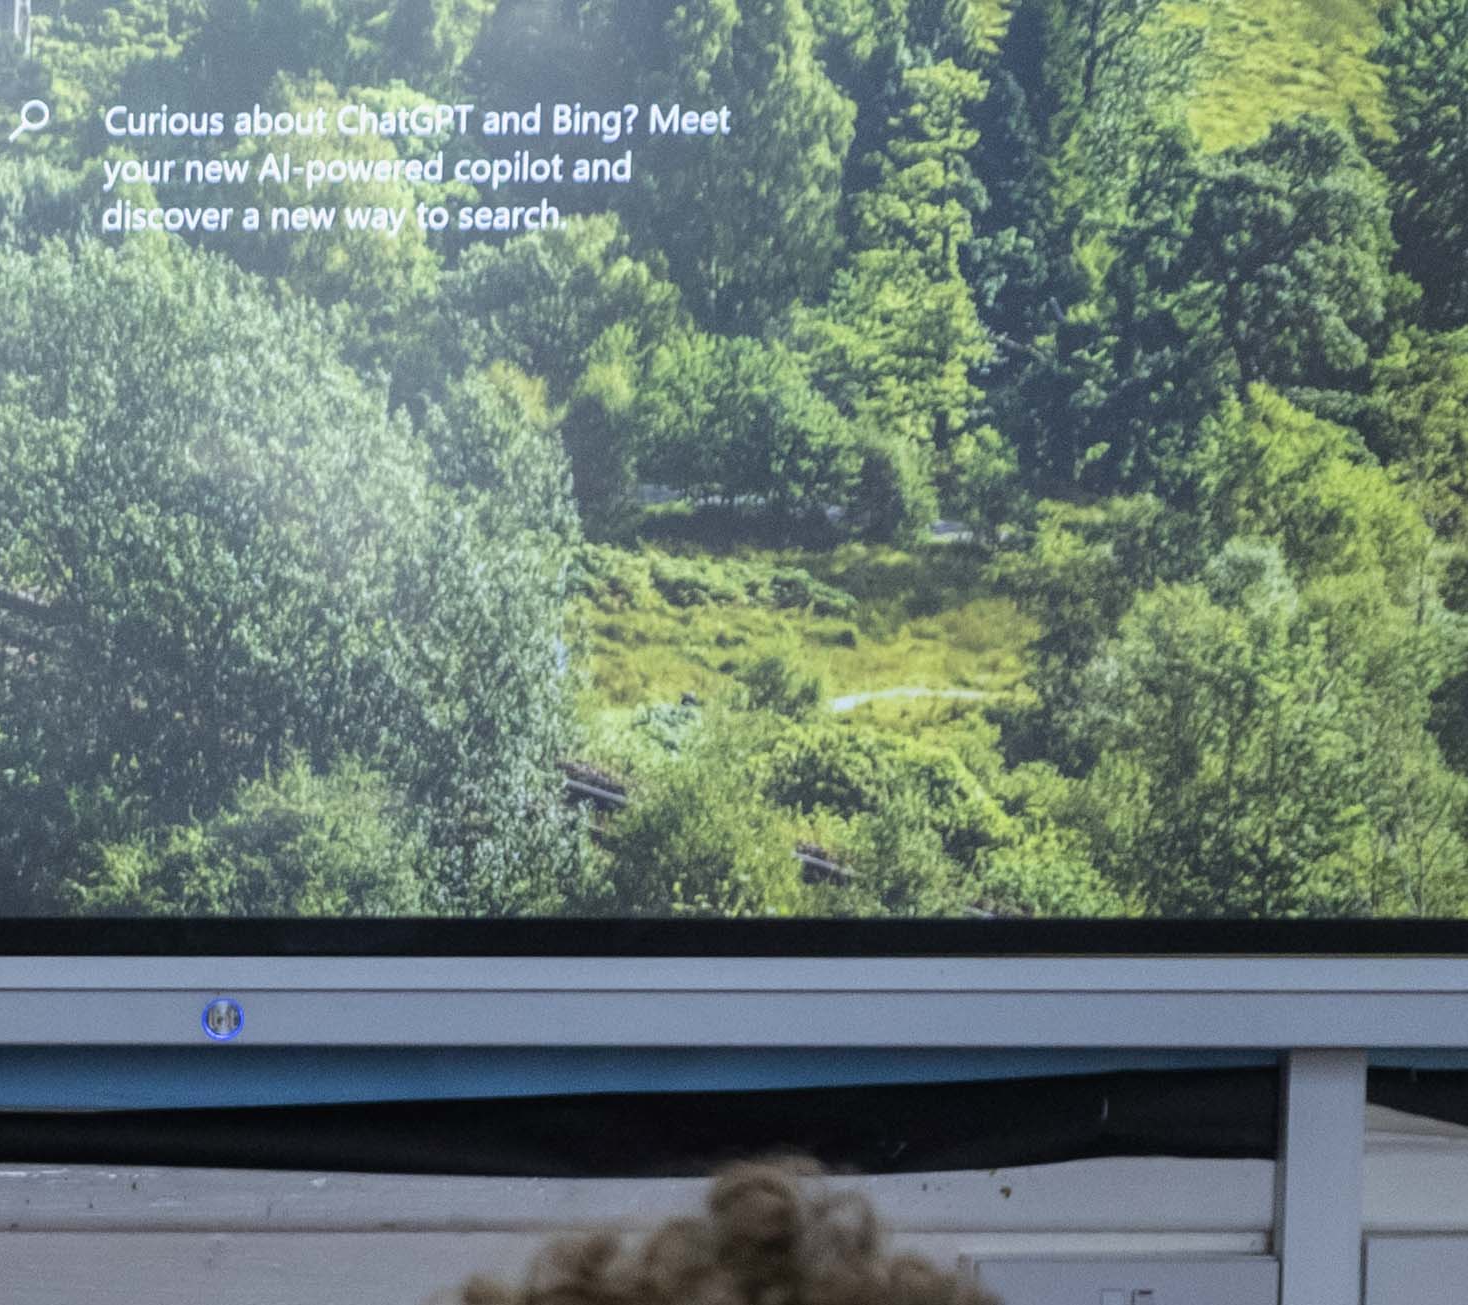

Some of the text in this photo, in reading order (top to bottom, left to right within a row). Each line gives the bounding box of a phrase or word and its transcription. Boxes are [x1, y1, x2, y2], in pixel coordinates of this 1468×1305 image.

[104, 104, 731, 144] Curious about ChatGPT and Bing? Meet
[102, 151, 633, 189] your new AI-powered copilot and
[101, 198, 568, 238] discover a new way to search.
